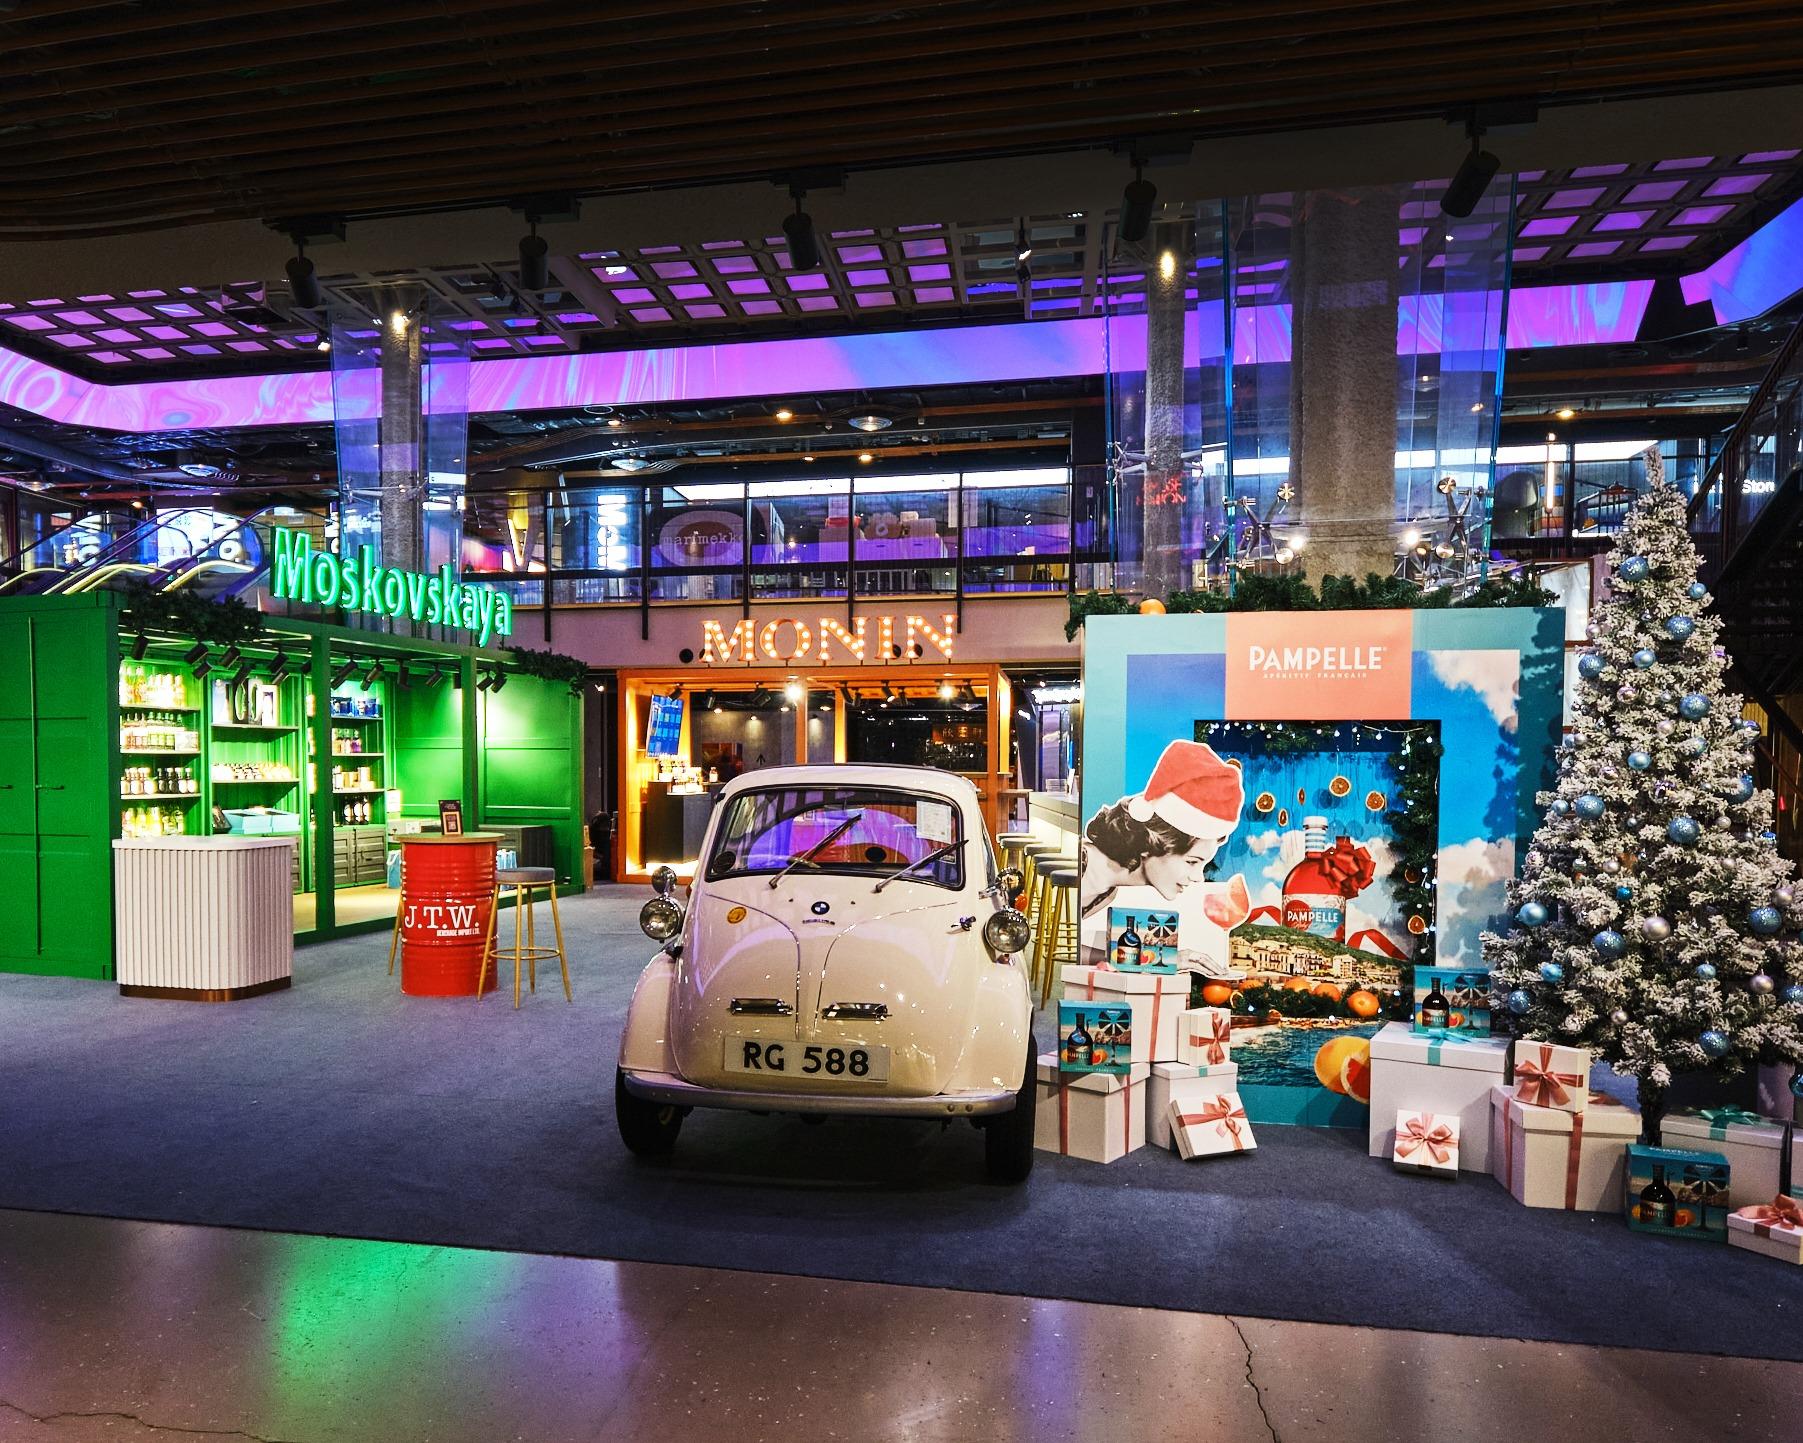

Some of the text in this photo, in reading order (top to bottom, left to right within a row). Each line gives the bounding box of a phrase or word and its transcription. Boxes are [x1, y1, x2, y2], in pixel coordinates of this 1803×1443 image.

[271, 525, 512, 648] Moskovskaya
[698, 614, 958, 664] MONIN
[1249, 645, 1383, 671] PAMPELLE
[404, 905, 480, 930] J.T.W.
[1287, 911, 1339, 923] PAMPELLE
[743, 1041, 869, 1076] RG 588
